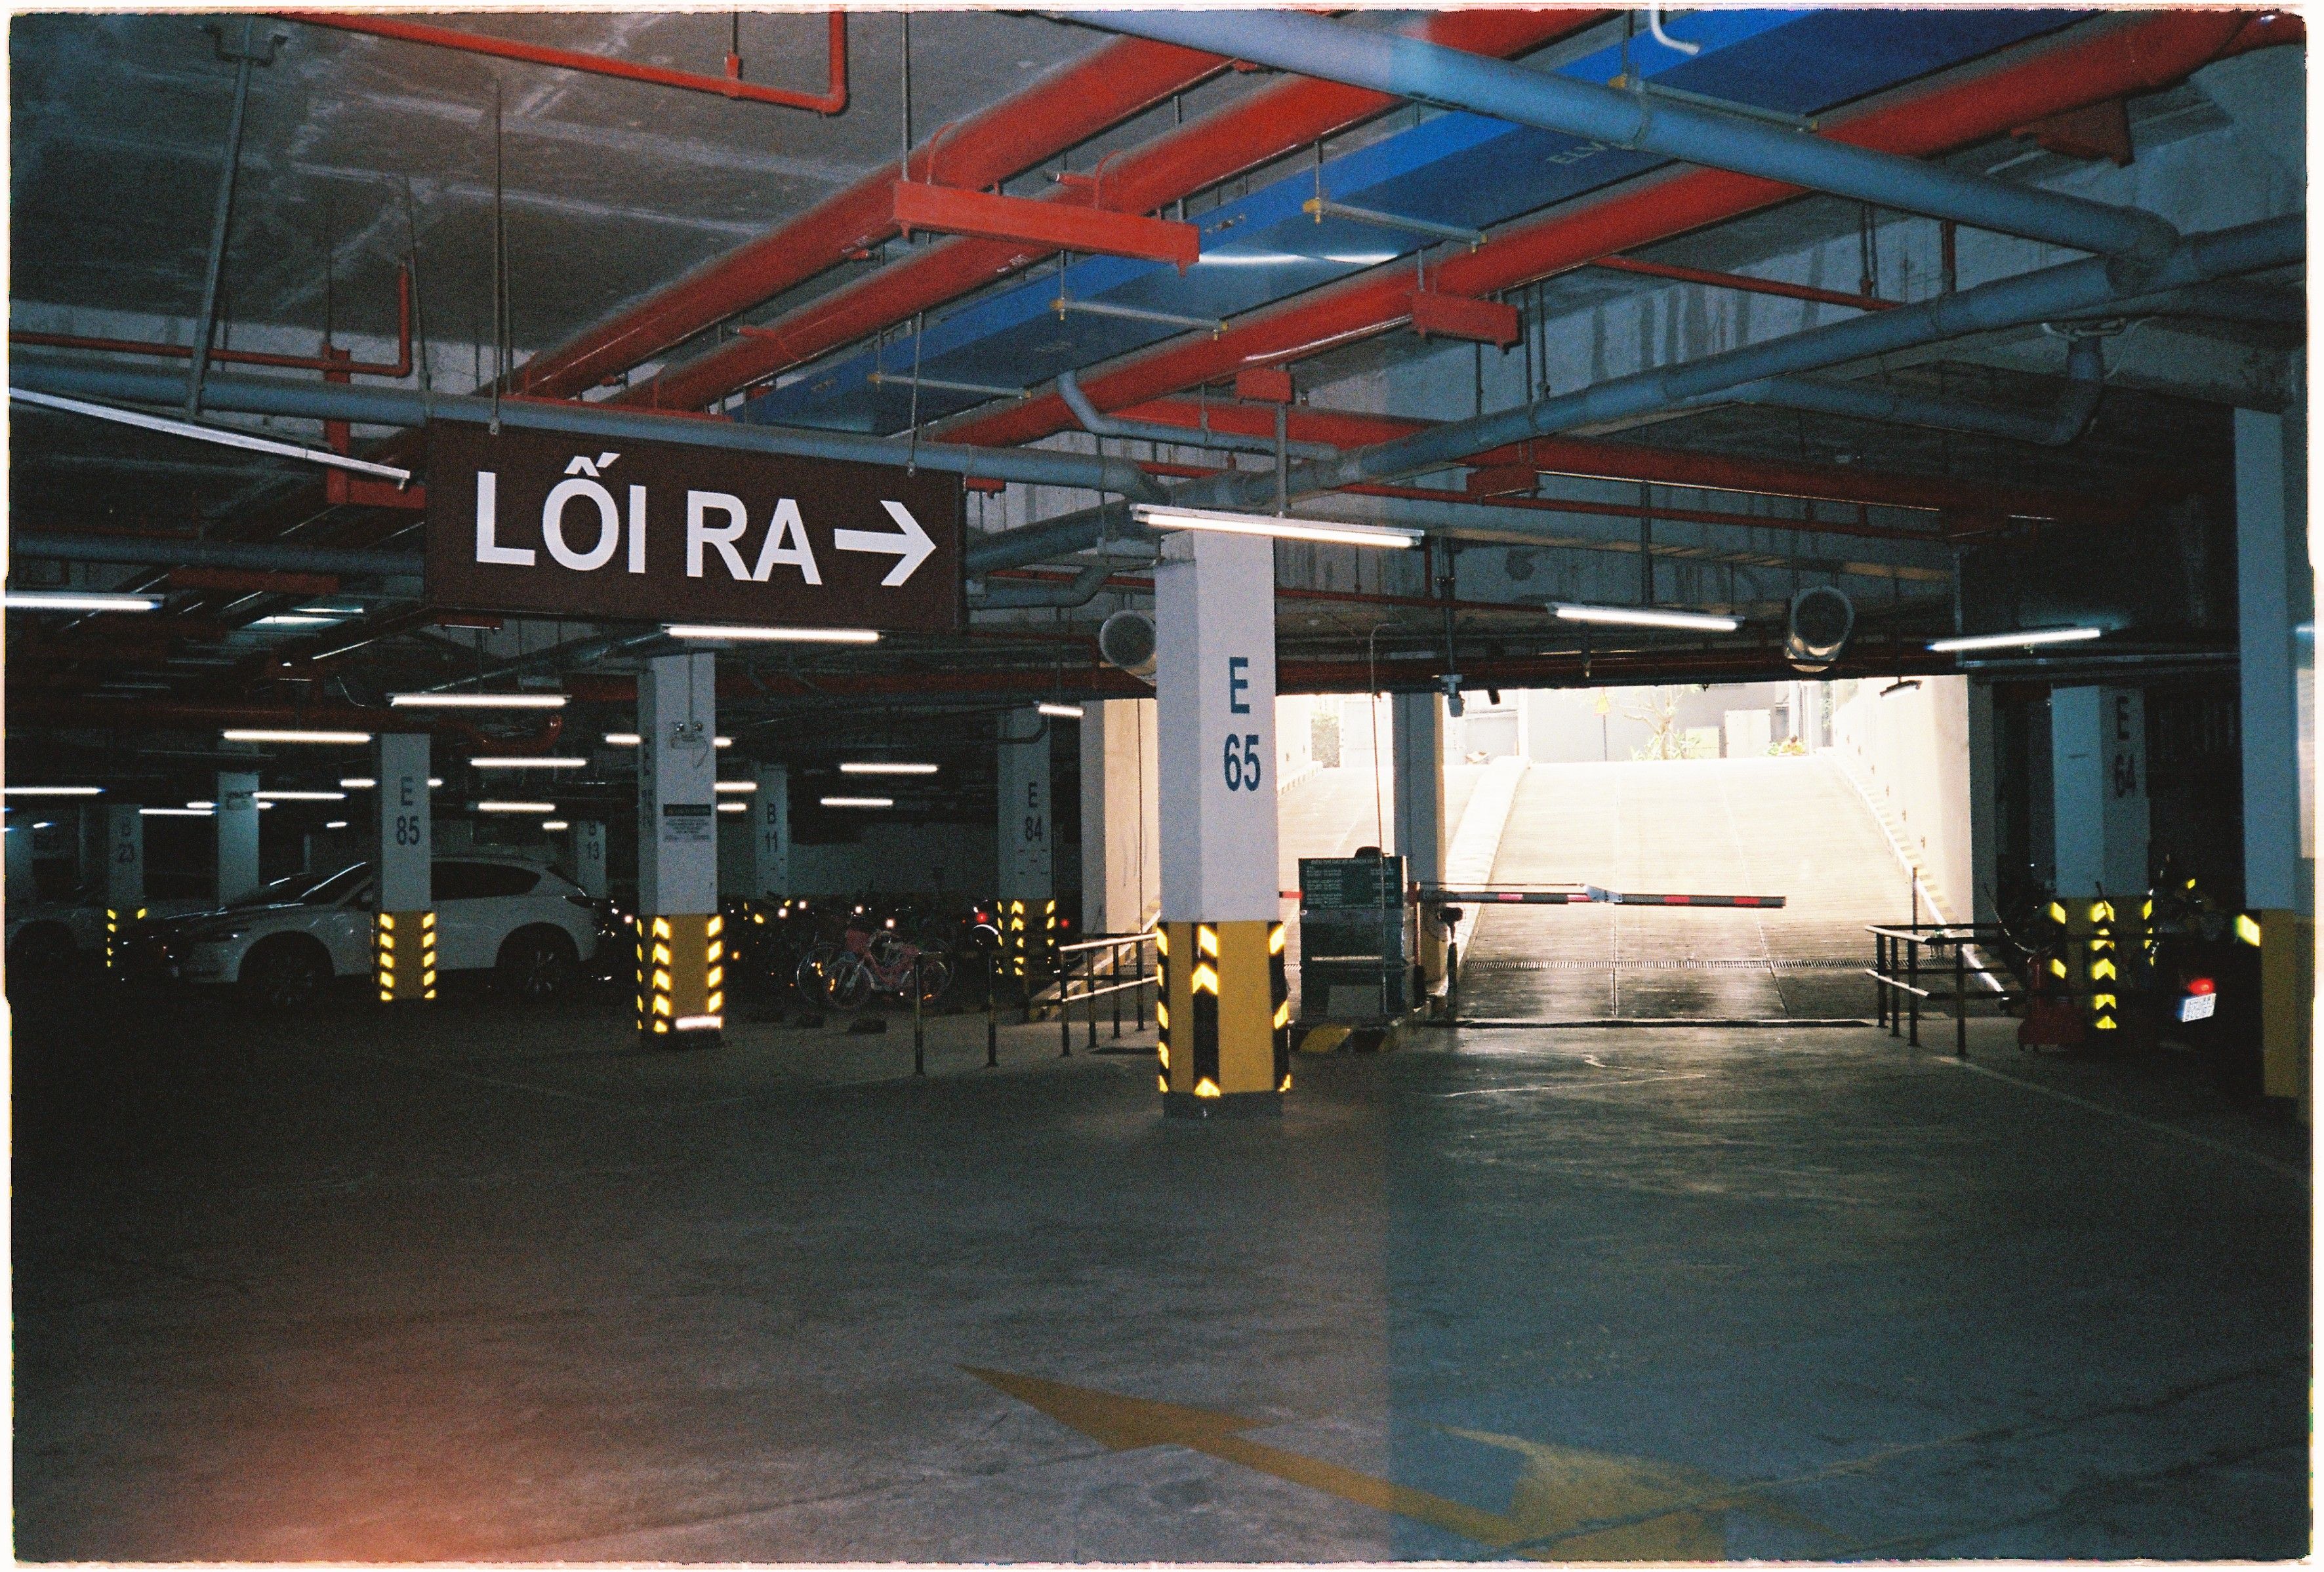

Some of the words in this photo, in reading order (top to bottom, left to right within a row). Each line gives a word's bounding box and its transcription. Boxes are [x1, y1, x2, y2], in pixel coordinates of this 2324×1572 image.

[476, 453, 646, 574] LỐI
[686, 490, 823, 585] RA
[1229, 656, 1250, 714] E
[2115, 696, 2129, 740] E
[1223, 733, 1261, 792] 65
[2113, 754, 2136, 799] 64
[401, 776, 414, 807] E
[1028, 782, 1038, 808] E
[766, 802, 777, 825] B
[1025, 815, 1044, 842] 84
[396, 815, 420, 845] 85
[764, 831, 779, 853] 11
[117, 842, 135, 864] 23
[587, 841, 600, 860] 13
